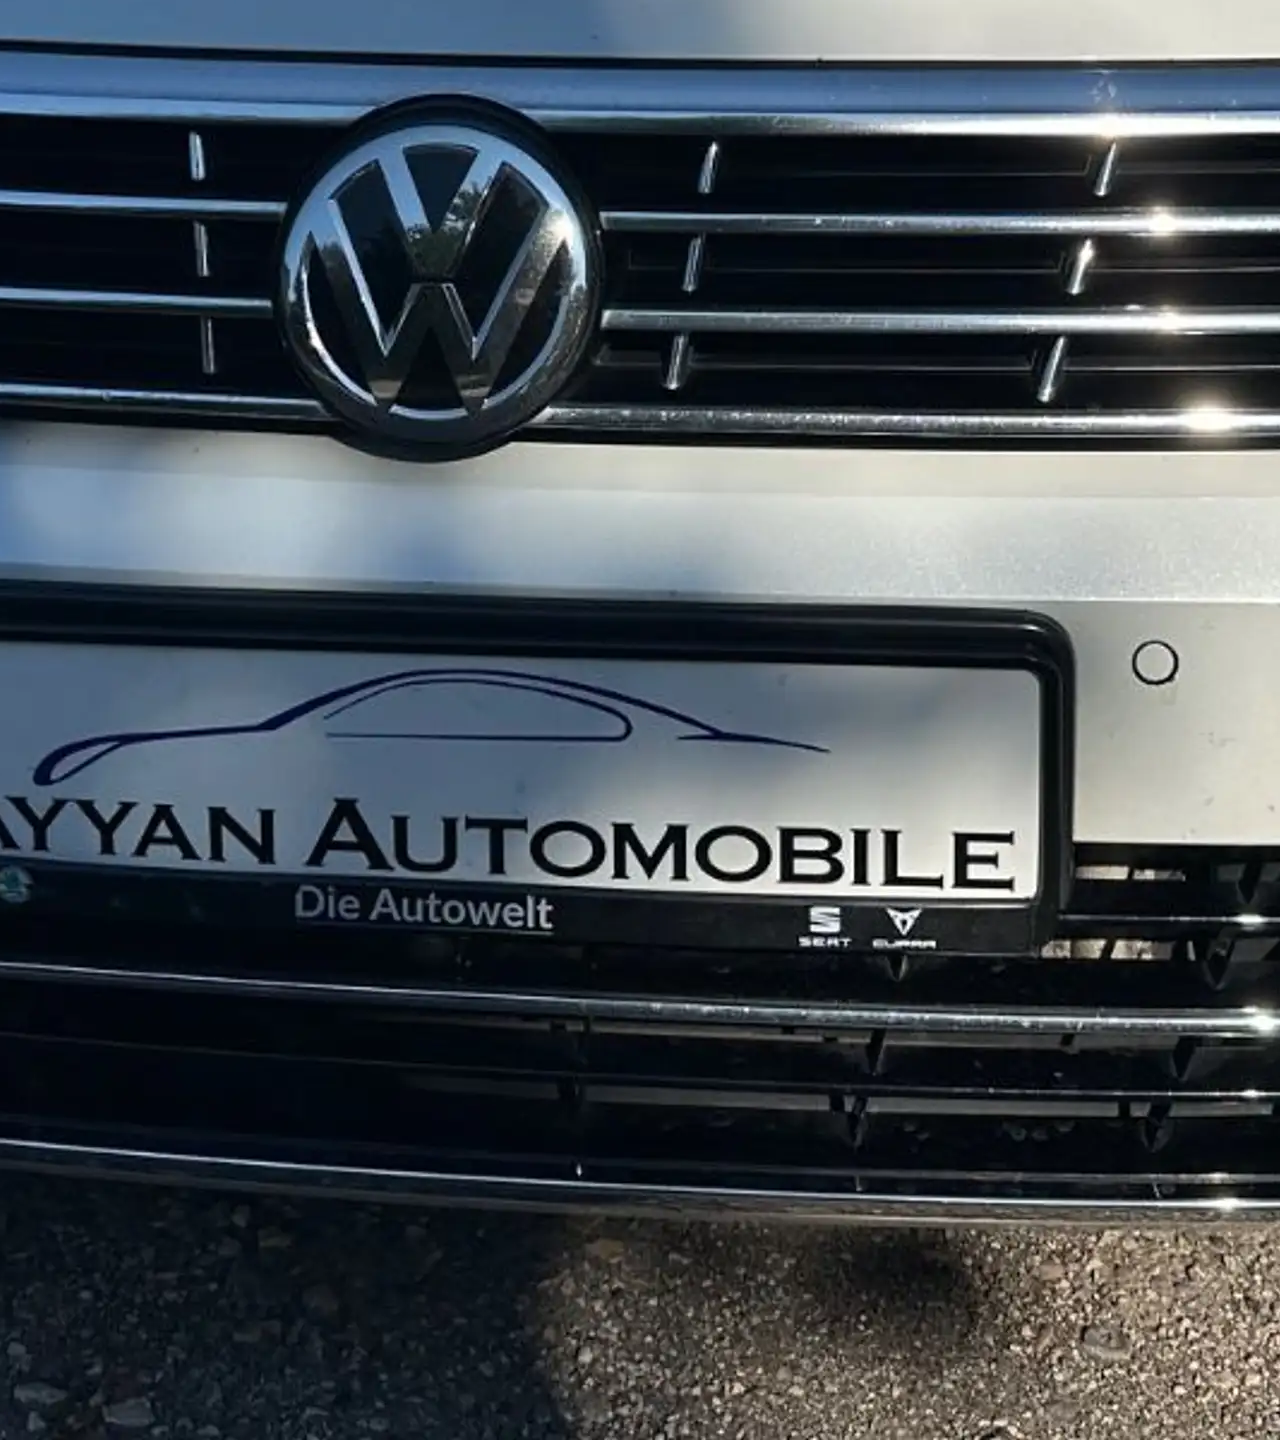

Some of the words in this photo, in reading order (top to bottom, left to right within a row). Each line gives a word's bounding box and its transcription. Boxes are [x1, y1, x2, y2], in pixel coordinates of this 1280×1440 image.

[305, 797, 1014, 891] AUTOMOBILE
[294, 886, 361, 919] Die
[370, 889, 553, 929] Autowelt
[798, 937, 852, 947] SEAT
